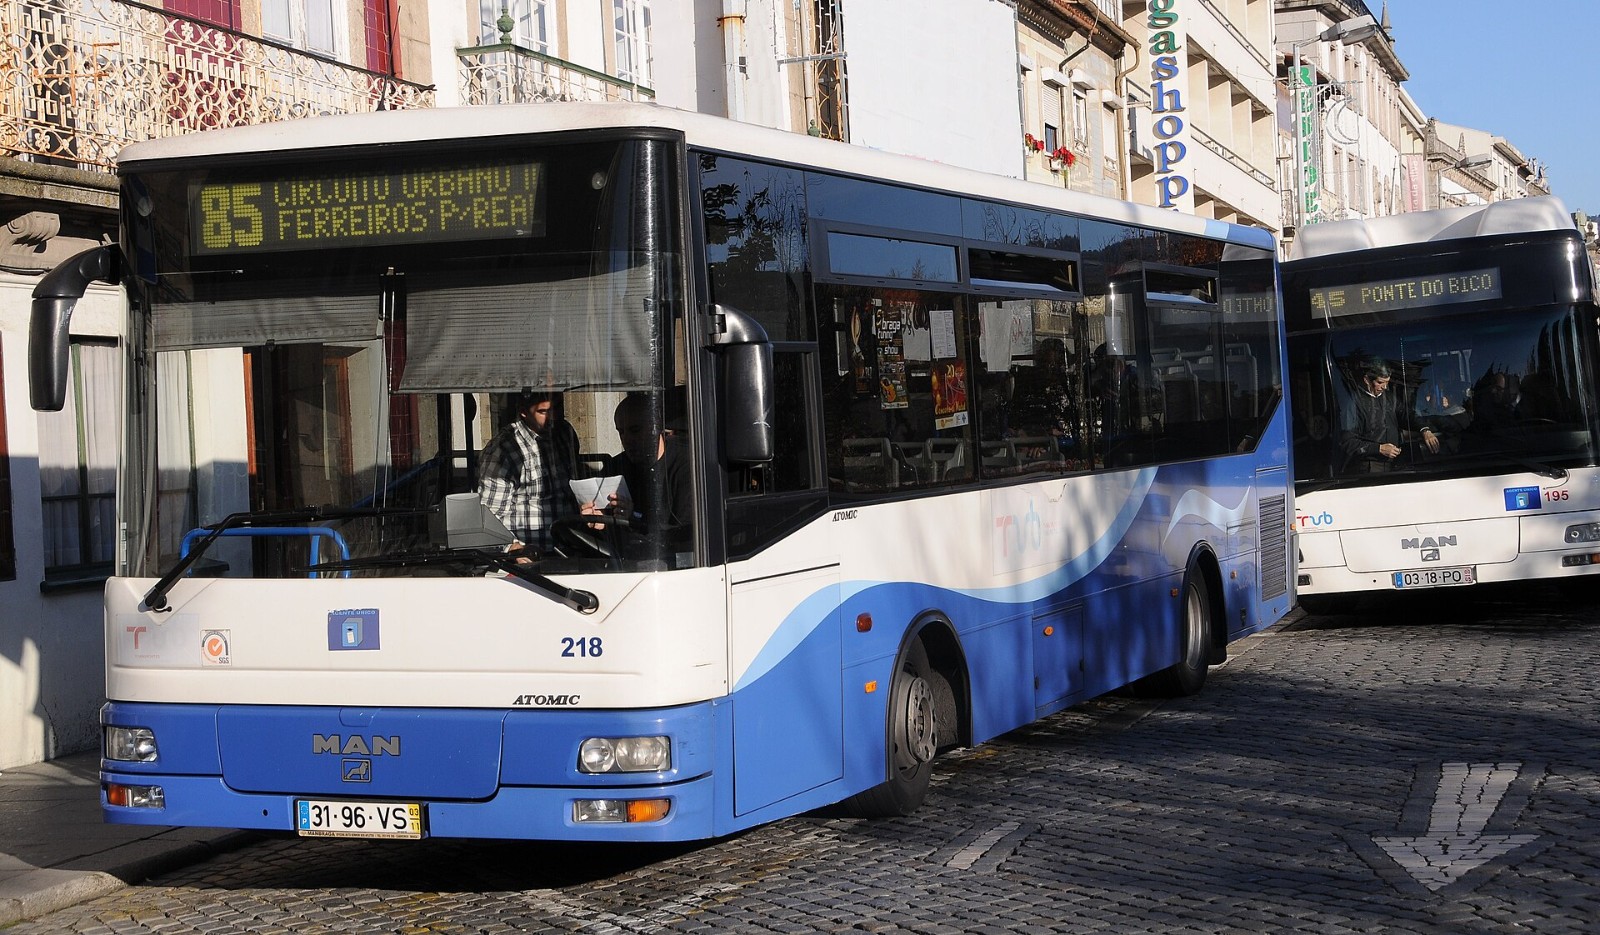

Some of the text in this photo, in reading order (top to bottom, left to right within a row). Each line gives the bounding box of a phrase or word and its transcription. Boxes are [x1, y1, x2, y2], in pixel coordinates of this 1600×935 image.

[1148, 0, 1189, 212] gashopp
[201, 184, 263, 248] 85
[279, 201, 428, 240] FERREIROS
[1361, 281, 1417, 304] PONTE
[1421, 279, 1444, 298] DO
[1448, 273, 1492, 294] BICO
[882, 317, 900, 333] braga
[884, 344, 898, 355] show
[1544, 490, 1569, 502] 195
[832, 509, 858, 522] ATOMIC
[1401, 535, 1457, 549] MAN
[561, 637, 603, 657] 218
[512, 694, 581, 706] ATOMIC
[312, 733, 400, 756] MAN
[409, 808, 419, 816] 03
[411, 822, 420, 831] 11
